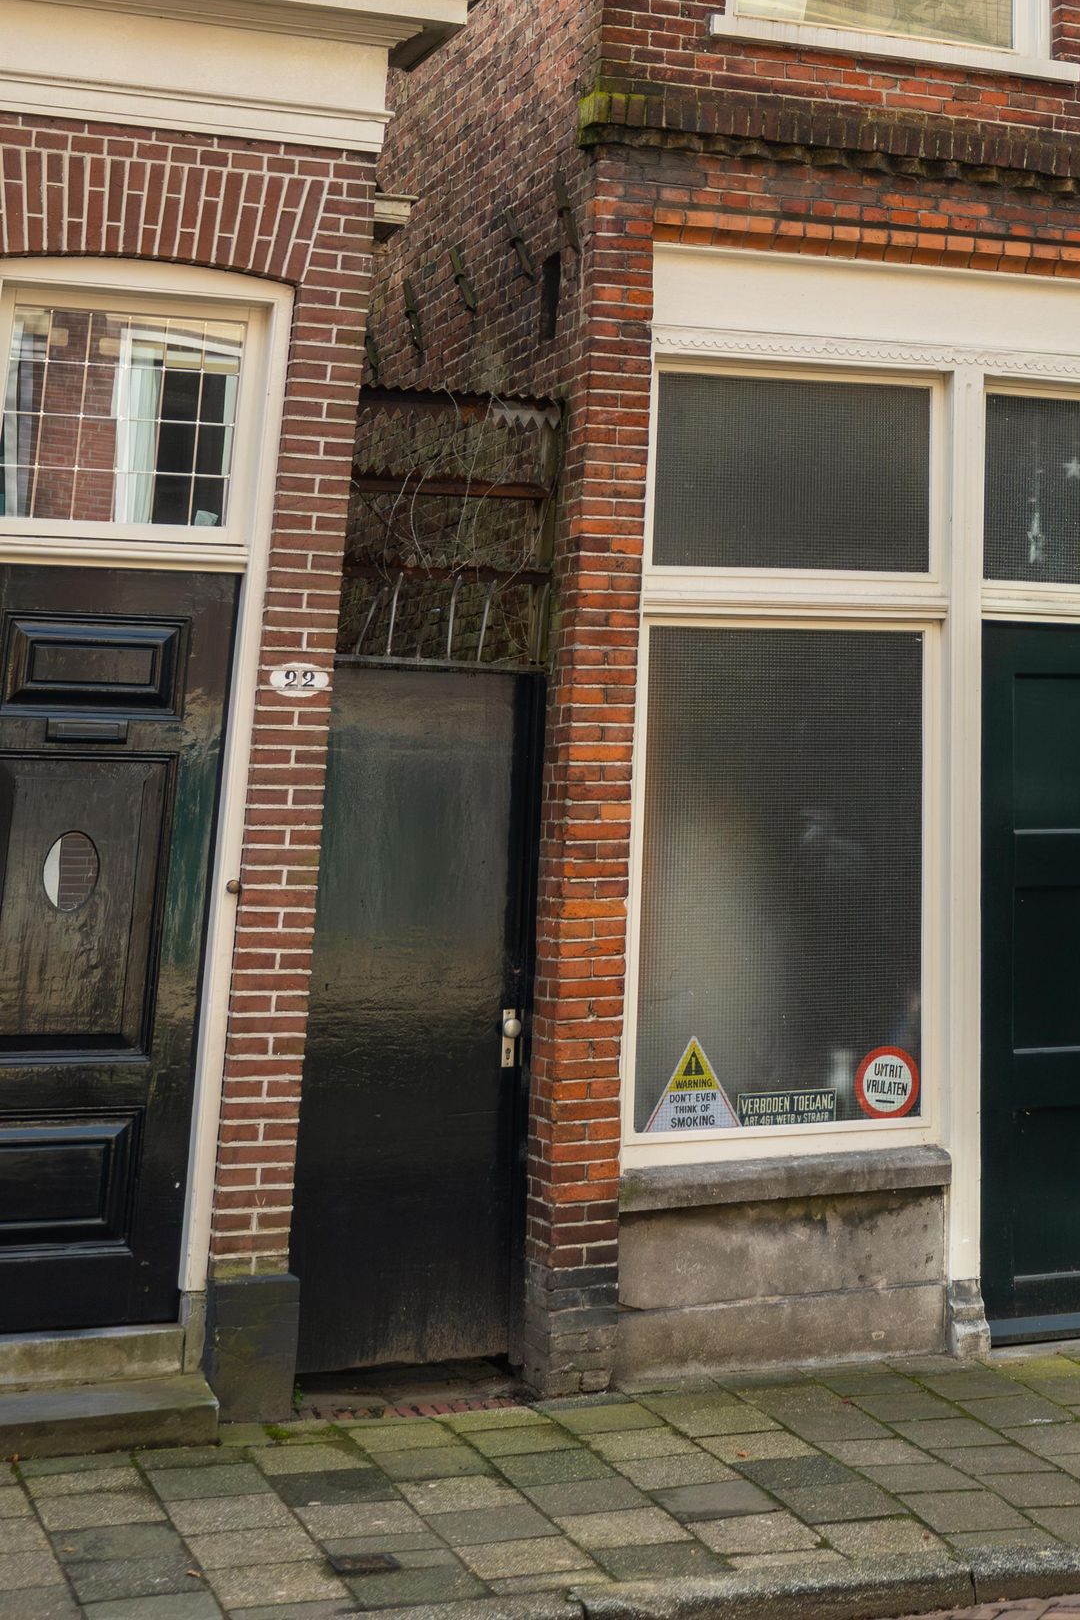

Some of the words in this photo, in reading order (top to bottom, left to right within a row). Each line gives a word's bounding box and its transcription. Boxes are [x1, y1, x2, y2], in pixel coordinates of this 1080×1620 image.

[284, 670, 315, 687] 22
[874, 1063, 903, 1078] UITRIT
[675, 1078, 713, 1089] WARNING
[866, 1079, 908, 1096] VRIJLATEN
[669, 1093, 692, 1103] DON'T
[695, 1092, 717, 1102] EVEN
[741, 1096, 790, 1114] VERBODEN
[793, 1094, 834, 1111] TOEGANG
[674, 1105, 697, 1114] THINK
[700, 1104, 711, 1112] OF
[670, 1115, 715, 1128] SMOKING
[760, 1115, 774, 1126] 461
